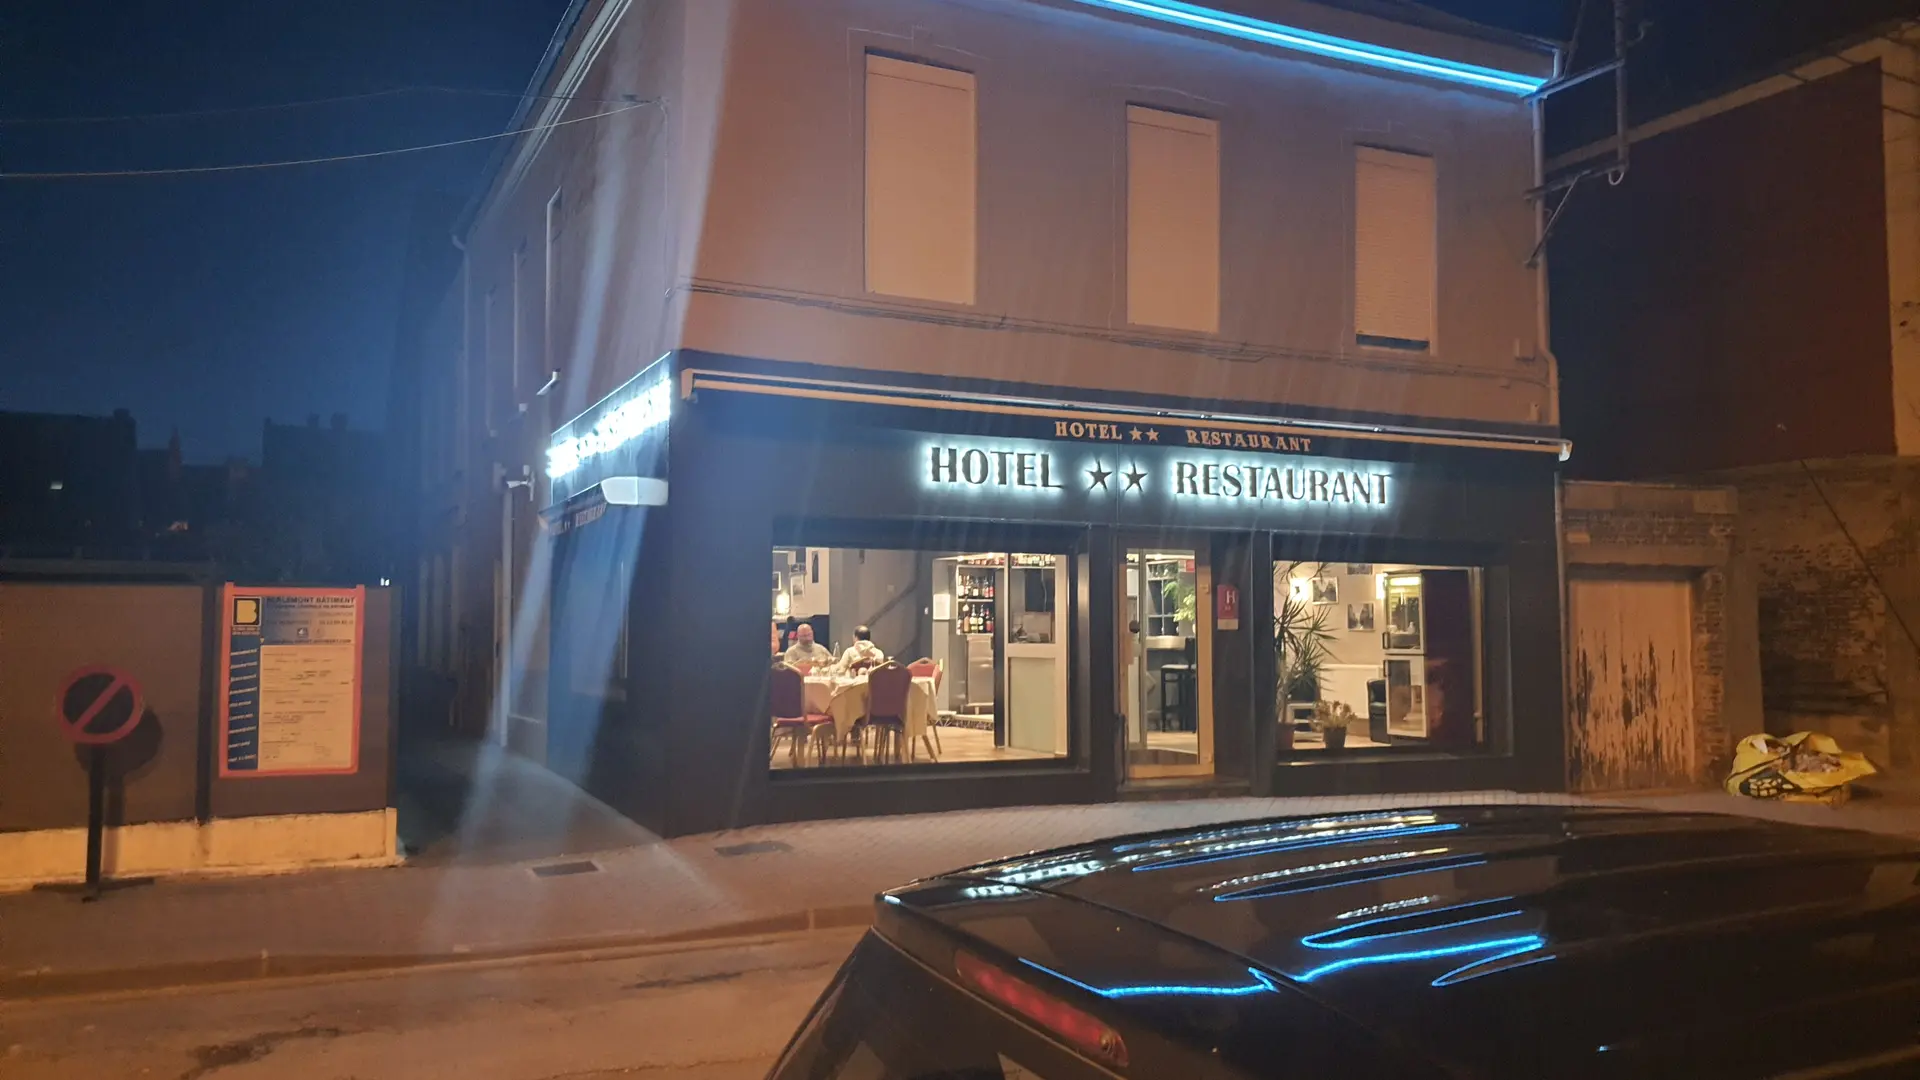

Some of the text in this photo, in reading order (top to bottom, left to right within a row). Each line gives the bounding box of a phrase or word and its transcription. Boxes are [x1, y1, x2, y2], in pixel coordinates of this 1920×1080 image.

[1055, 421, 1311, 452] HOTEL RESTAURANT
[931, 446, 1392, 505] HOTEL RESTAURANT
[1226, 590, 1236, 604] H
[236, 599, 258, 623] B
